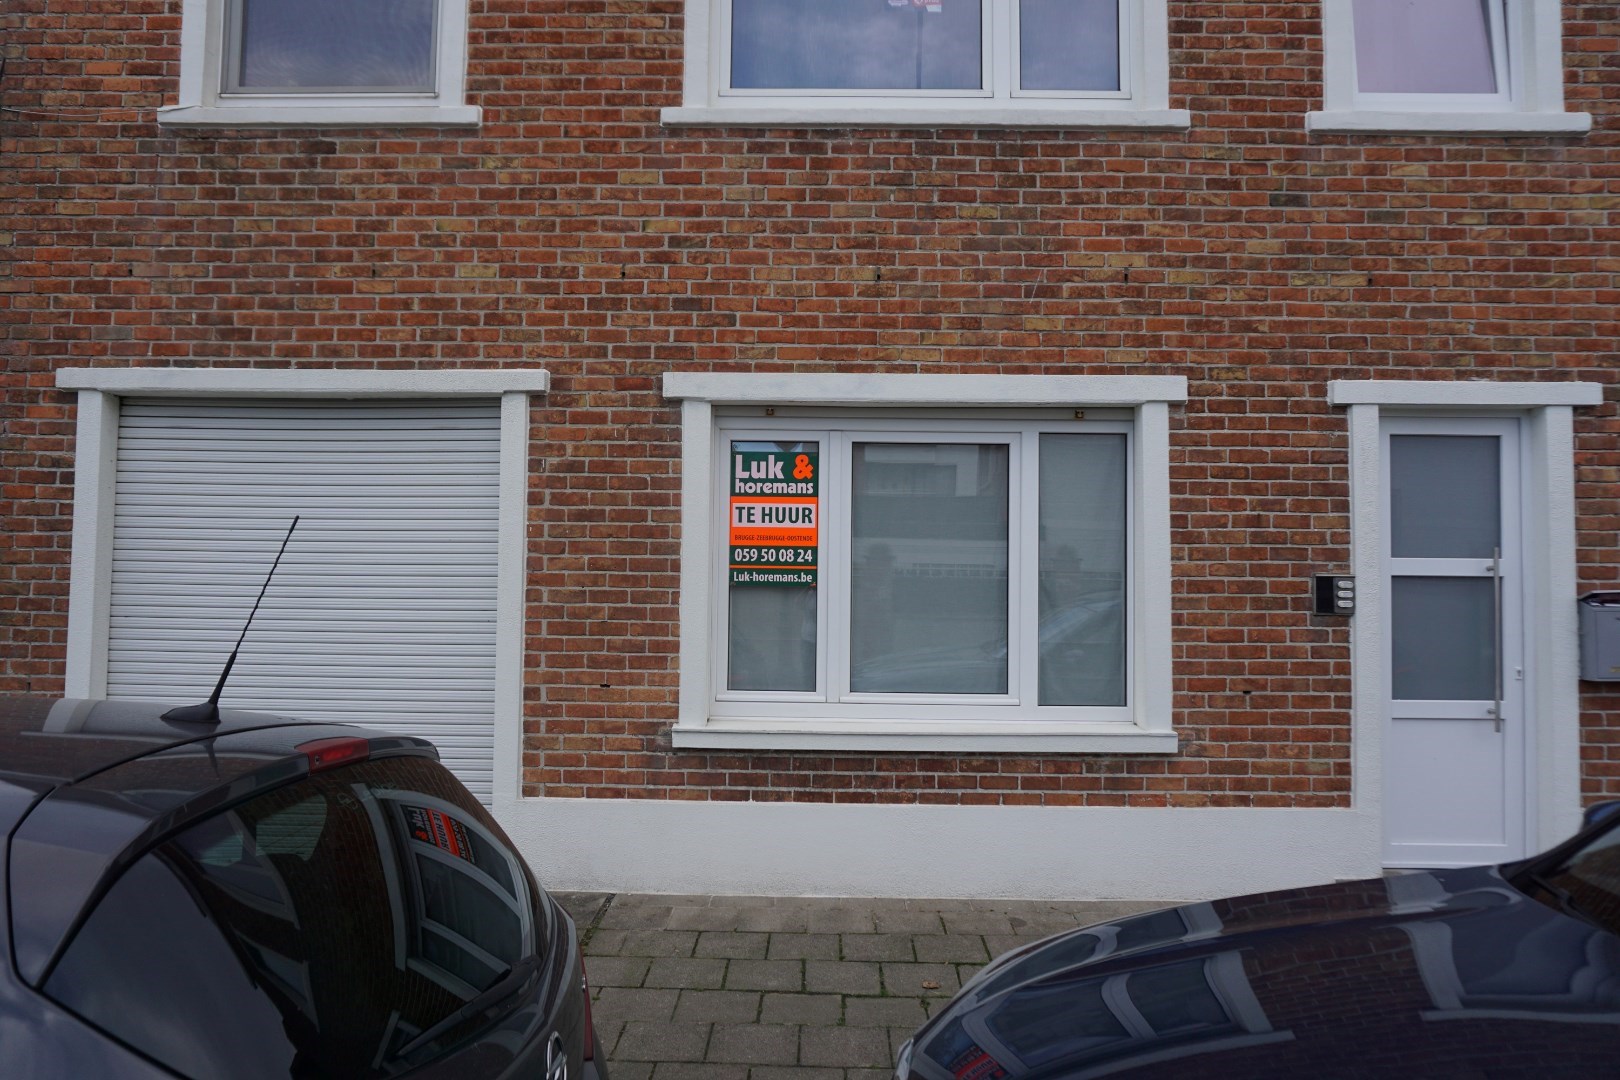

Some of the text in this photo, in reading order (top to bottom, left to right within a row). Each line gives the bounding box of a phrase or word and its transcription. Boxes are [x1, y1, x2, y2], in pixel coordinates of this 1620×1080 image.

[735, 454, 814, 480] Luk &
[735, 477, 814, 494] horemans
[735, 506, 813, 524] TE HUUR
[734, 548, 813, 563] 059 50 08 24
[733, 571, 813, 583] Luk-horemans.be
